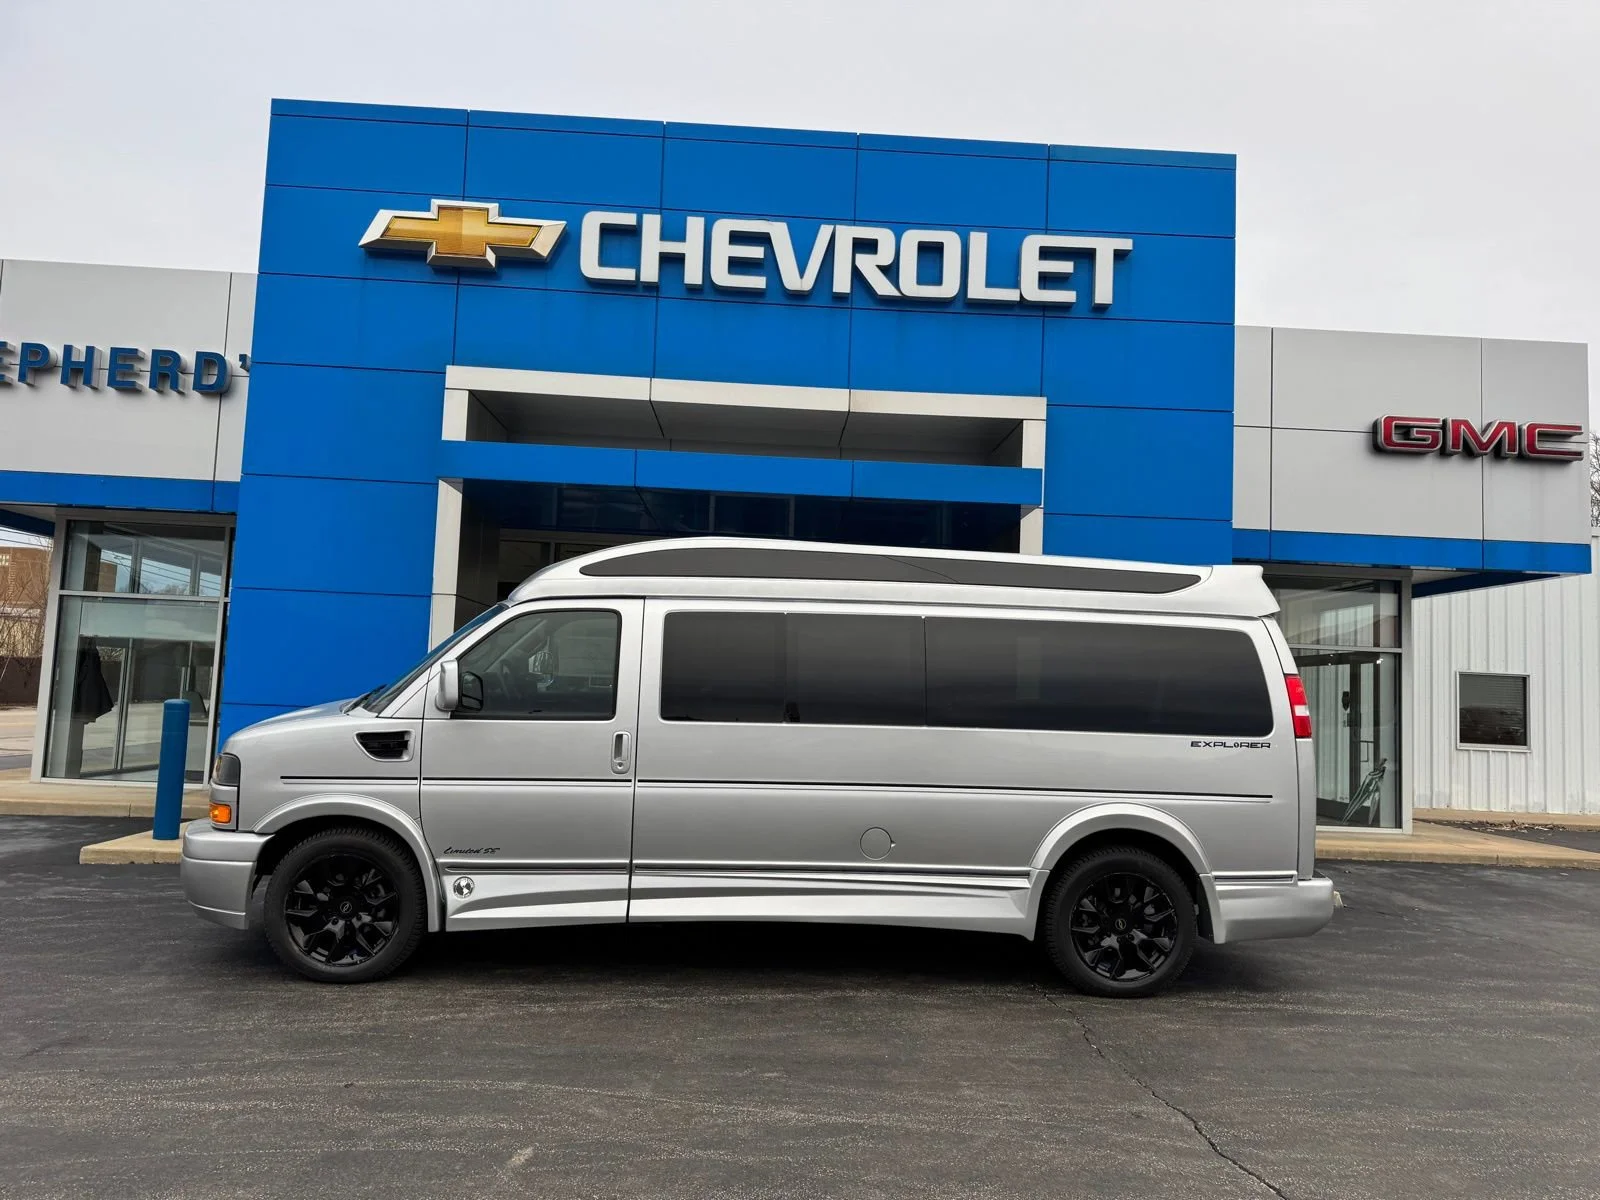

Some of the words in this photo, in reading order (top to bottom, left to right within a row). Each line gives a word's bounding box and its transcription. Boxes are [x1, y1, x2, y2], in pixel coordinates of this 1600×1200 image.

[579, 210, 1134, 308] CHEVROLET
[0, 340, 251, 394] PHERD'
[1374, 415, 1584, 461] GMC
[1190, 741, 1271, 749] EXPLORER
